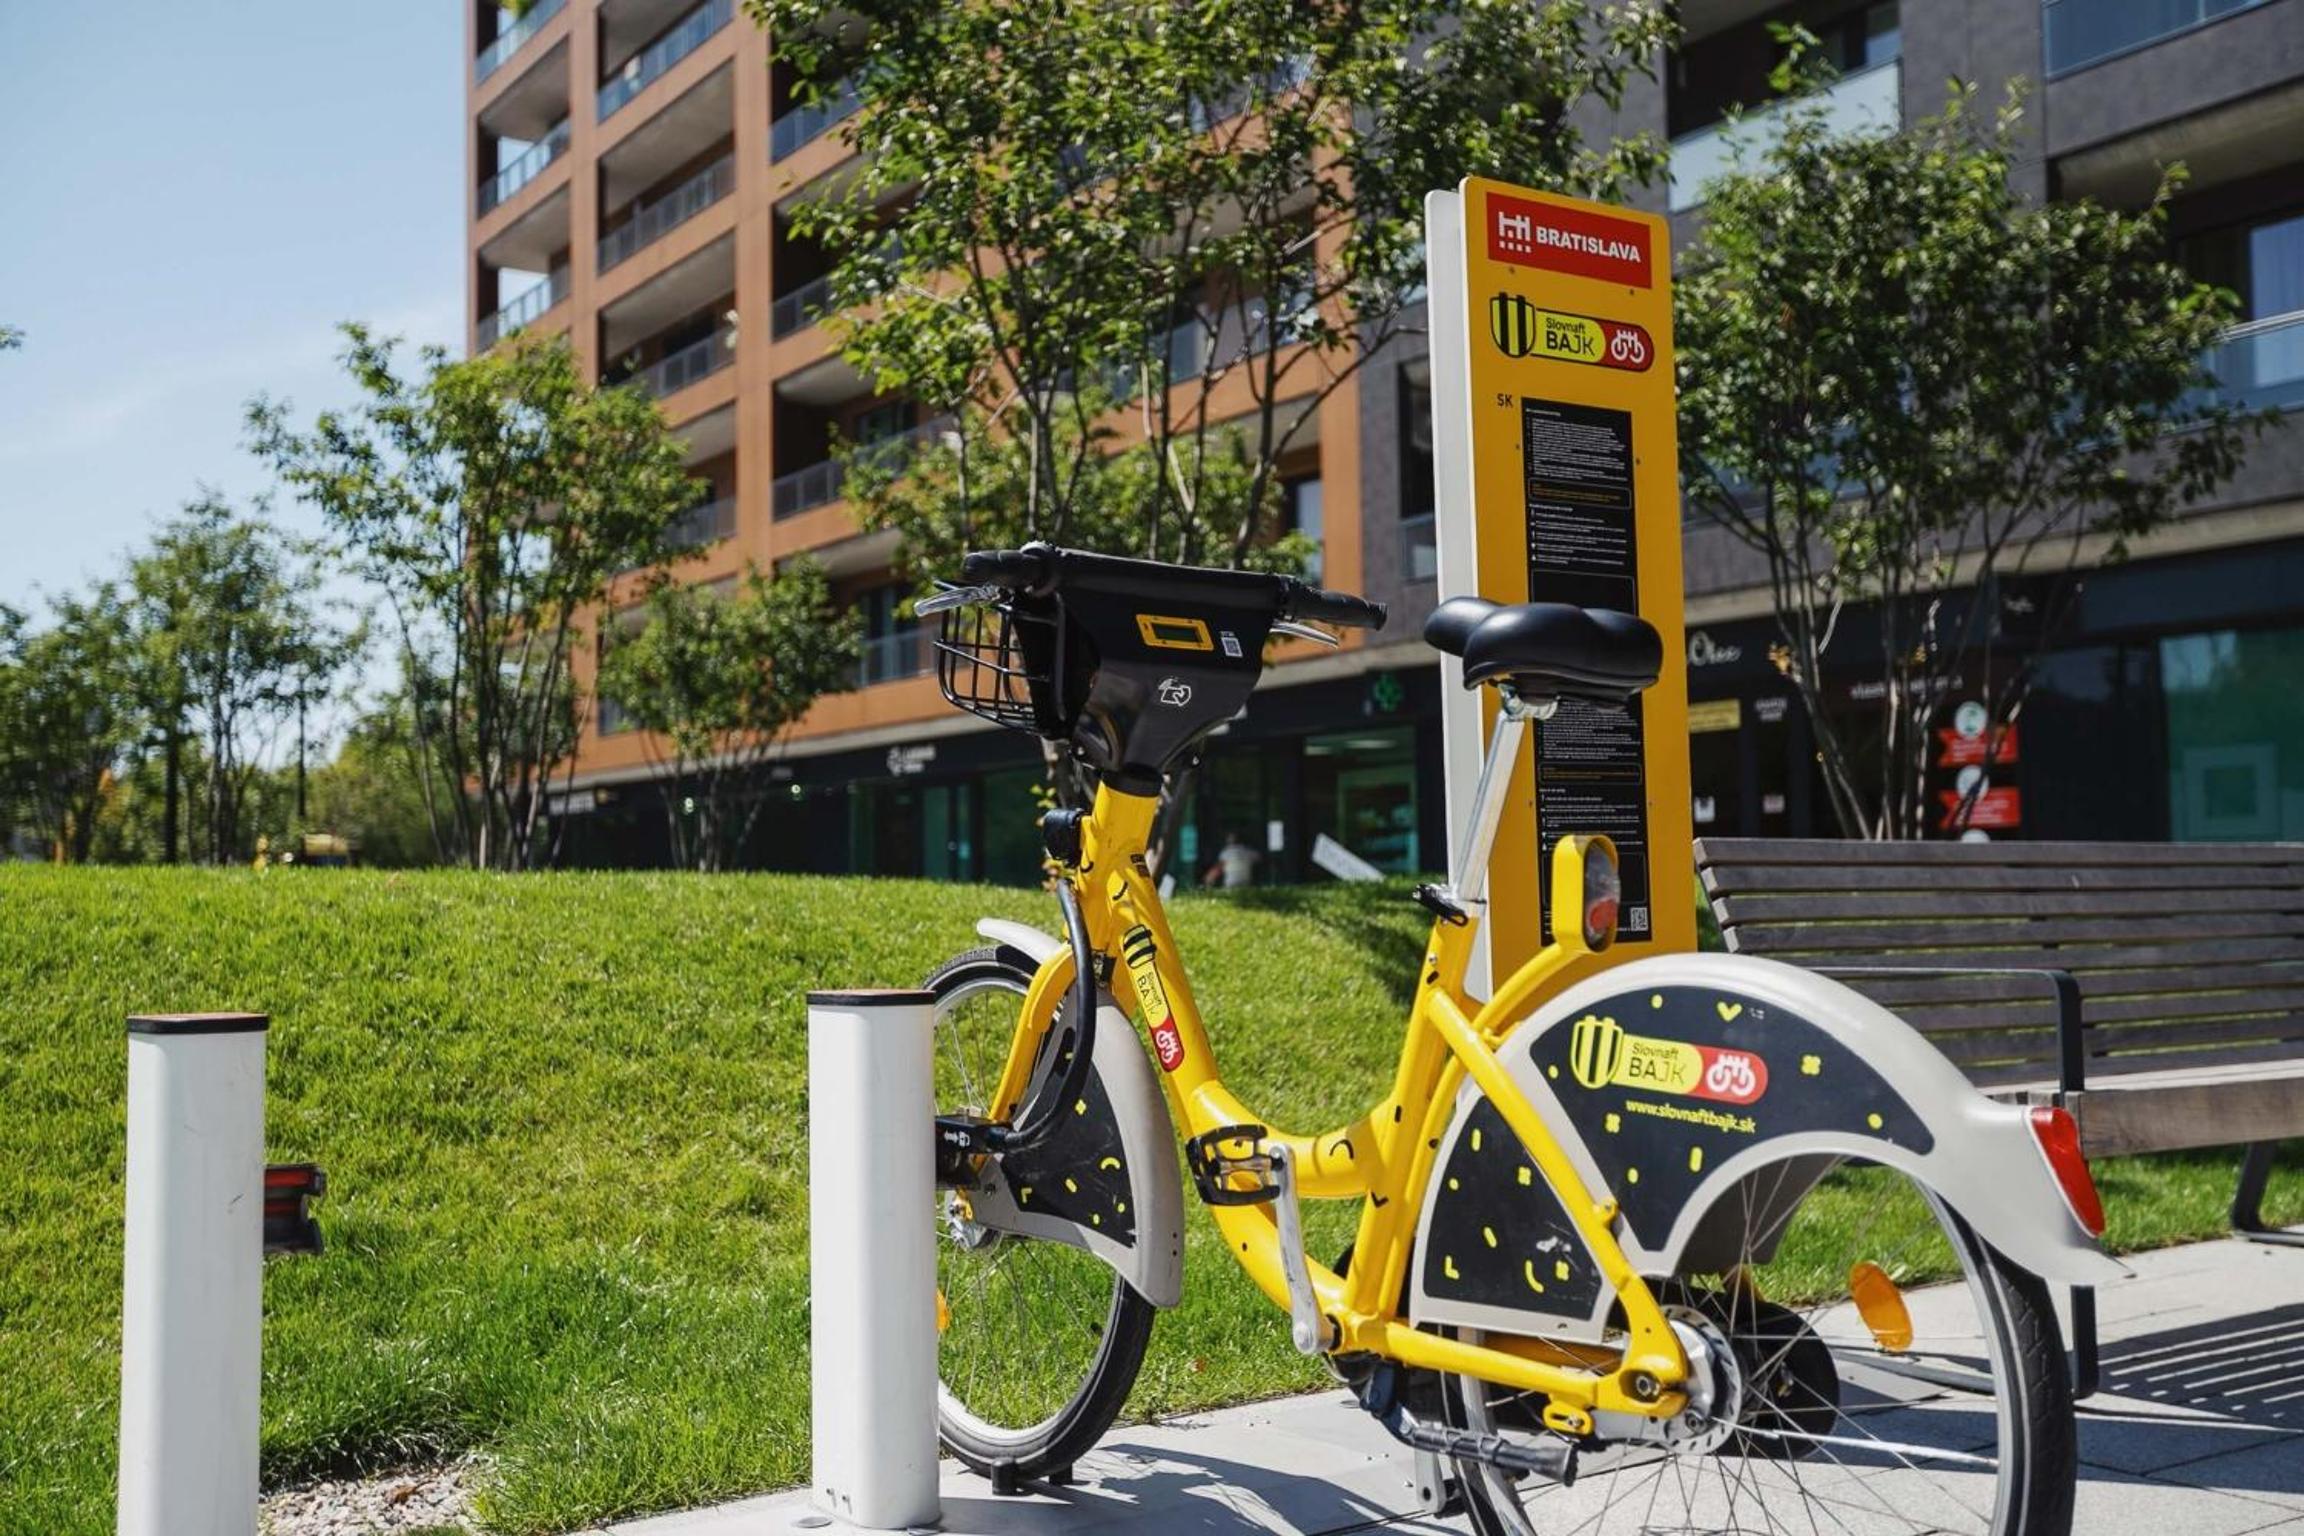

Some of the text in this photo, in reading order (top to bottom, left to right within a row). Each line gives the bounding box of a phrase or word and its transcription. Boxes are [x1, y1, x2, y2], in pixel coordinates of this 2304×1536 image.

[1536, 226, 1641, 263] BRATISLAVA
[1546, 317, 1586, 335] Slovnaft
[1546, 331, 1595, 356] BAJK
[1497, 393, 1513, 407] SK
[1632, 1042, 1679, 1060] Slovnaft
[1629, 1057, 1686, 1085] BAJK
[1626, 1100, 1756, 1134] www.slovnaftbajk.sk
